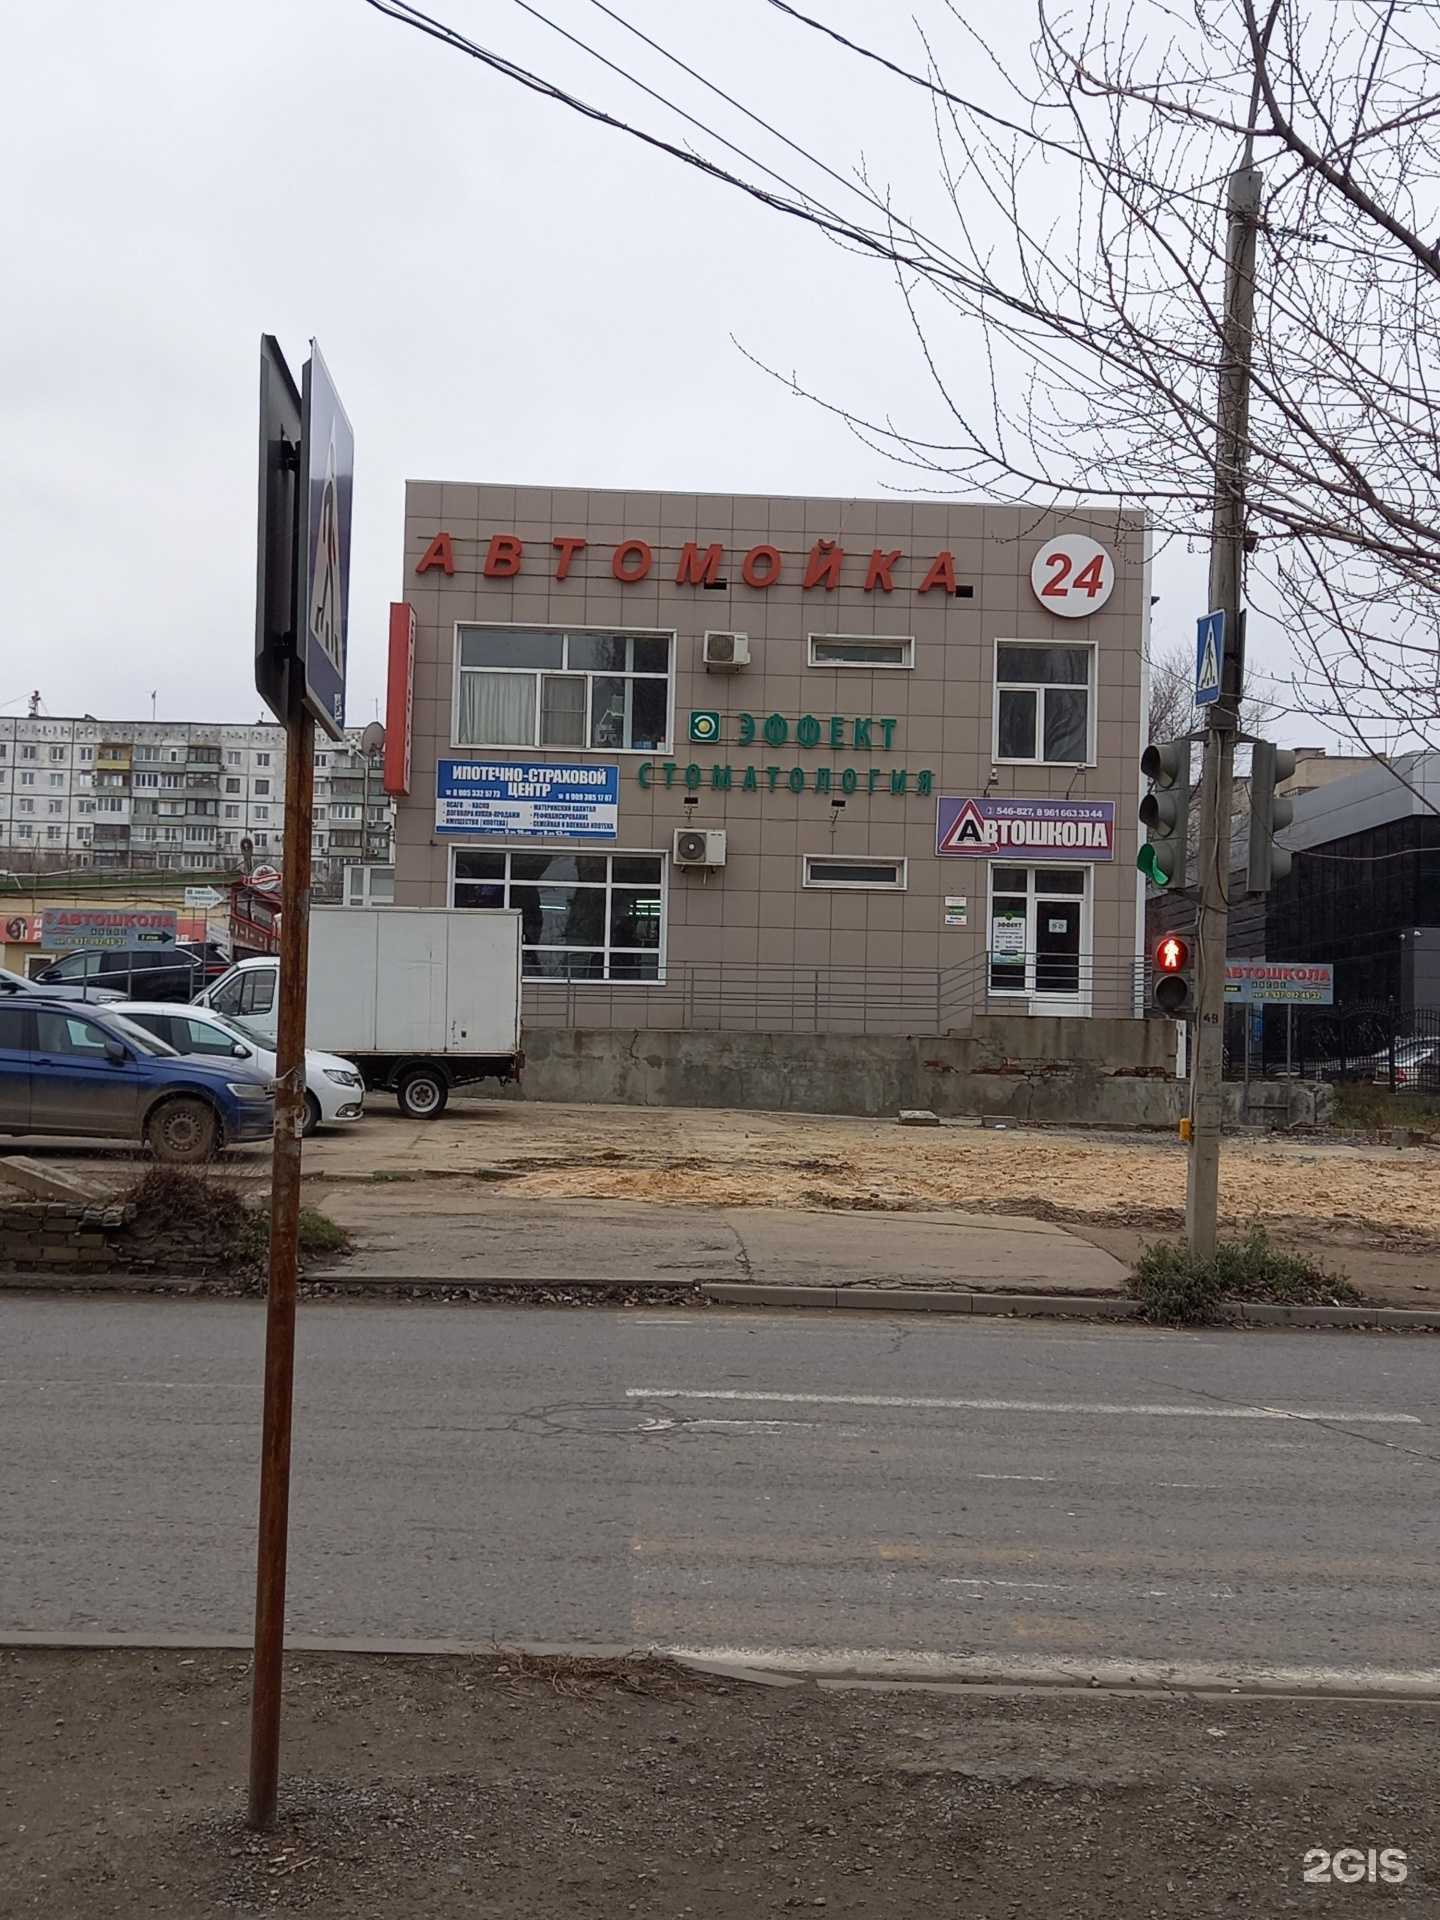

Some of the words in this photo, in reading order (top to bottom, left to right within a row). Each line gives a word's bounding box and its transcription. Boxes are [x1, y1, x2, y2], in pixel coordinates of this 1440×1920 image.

[415, 532, 957, 593] АВТОМОЙКА
[1041, 553, 1105, 598] 24
[737, 713, 897, 751] ЭФФЕКТ
[452, 765, 607, 785] ИПОТЕЧНО-СТРАХОВОЙ
[638, 762, 936, 797] СТОМАТОЛОГИЯ
[507, 782, 551, 798] ЦЕНТР
[996, 807, 1034, 817] 546-827,
[1036, 808, 1043, 816] 8
[957, 819, 1108, 847] АВТОШКОЛА
[58, 912, 175, 929] АВТОШКОЛА
